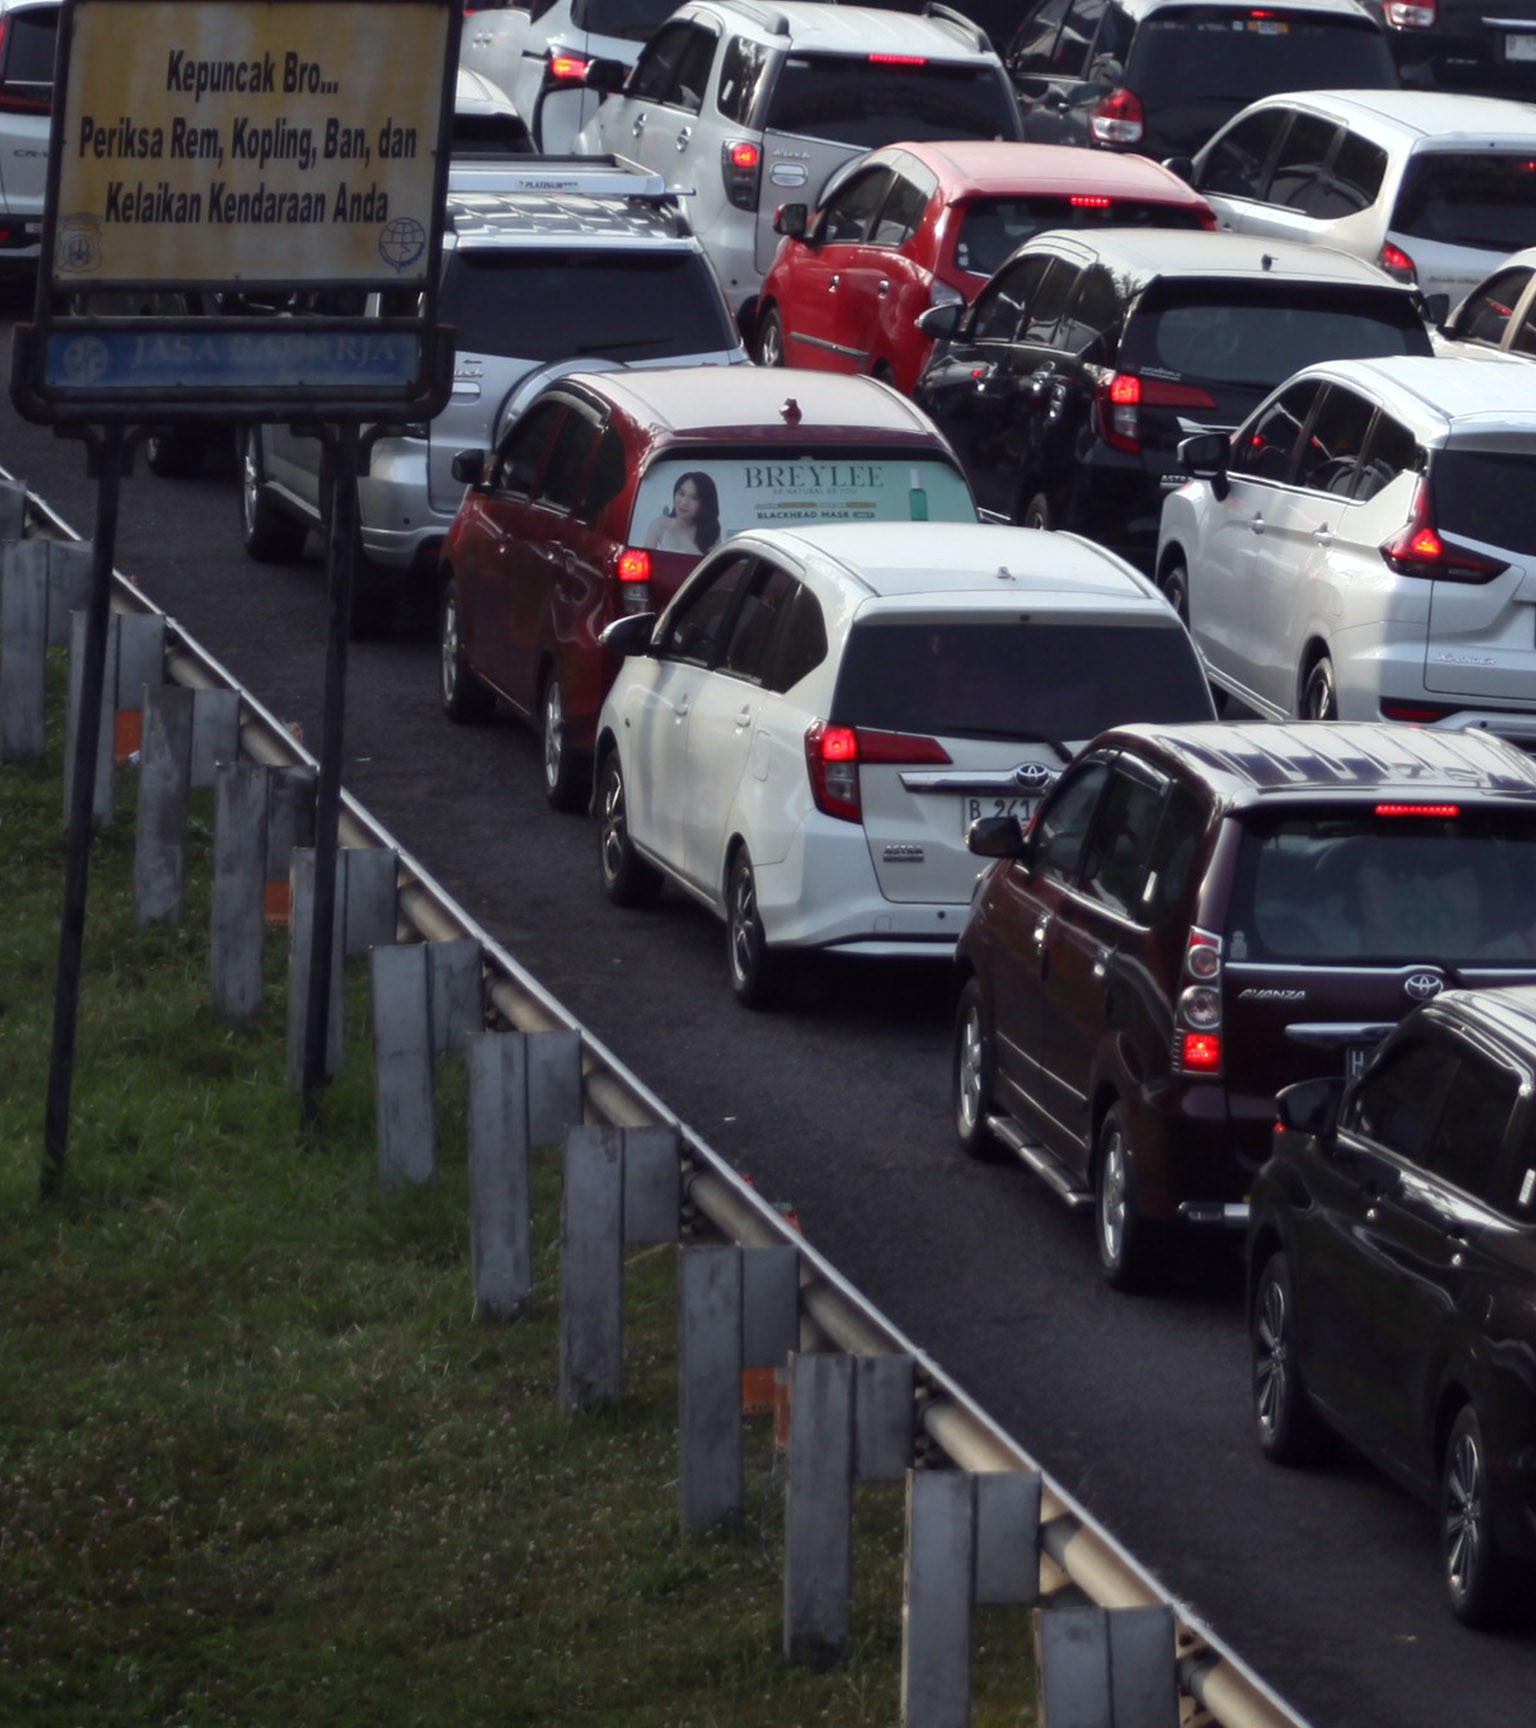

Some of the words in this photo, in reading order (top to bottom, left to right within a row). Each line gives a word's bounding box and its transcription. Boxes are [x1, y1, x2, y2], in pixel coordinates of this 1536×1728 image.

[166, 49, 276, 102] Kepuncak
[283, 51, 340, 94] Bro...
[78, 116, 164, 159] Periksa
[170, 116, 224, 169] Rem,
[231, 117, 317, 170] Kopling,
[323, 117, 370, 166] Ban,
[378, 117, 417, 159] dan
[105, 182, 202, 224] Kelaikan
[208, 182, 326, 224] Kendaraan
[332, 183, 389, 224] Anda
[131, 335, 220, 366] JASA
[744, 465, 885, 489] BREYLEE
[757, 510, 818, 520] BLACKHEAD
[821, 510, 850, 520] MASK
[969, 798, 982, 821] B
[1237, 988, 1306, 1001] AVANZA
[1352, 1050, 1364, 1076] H
